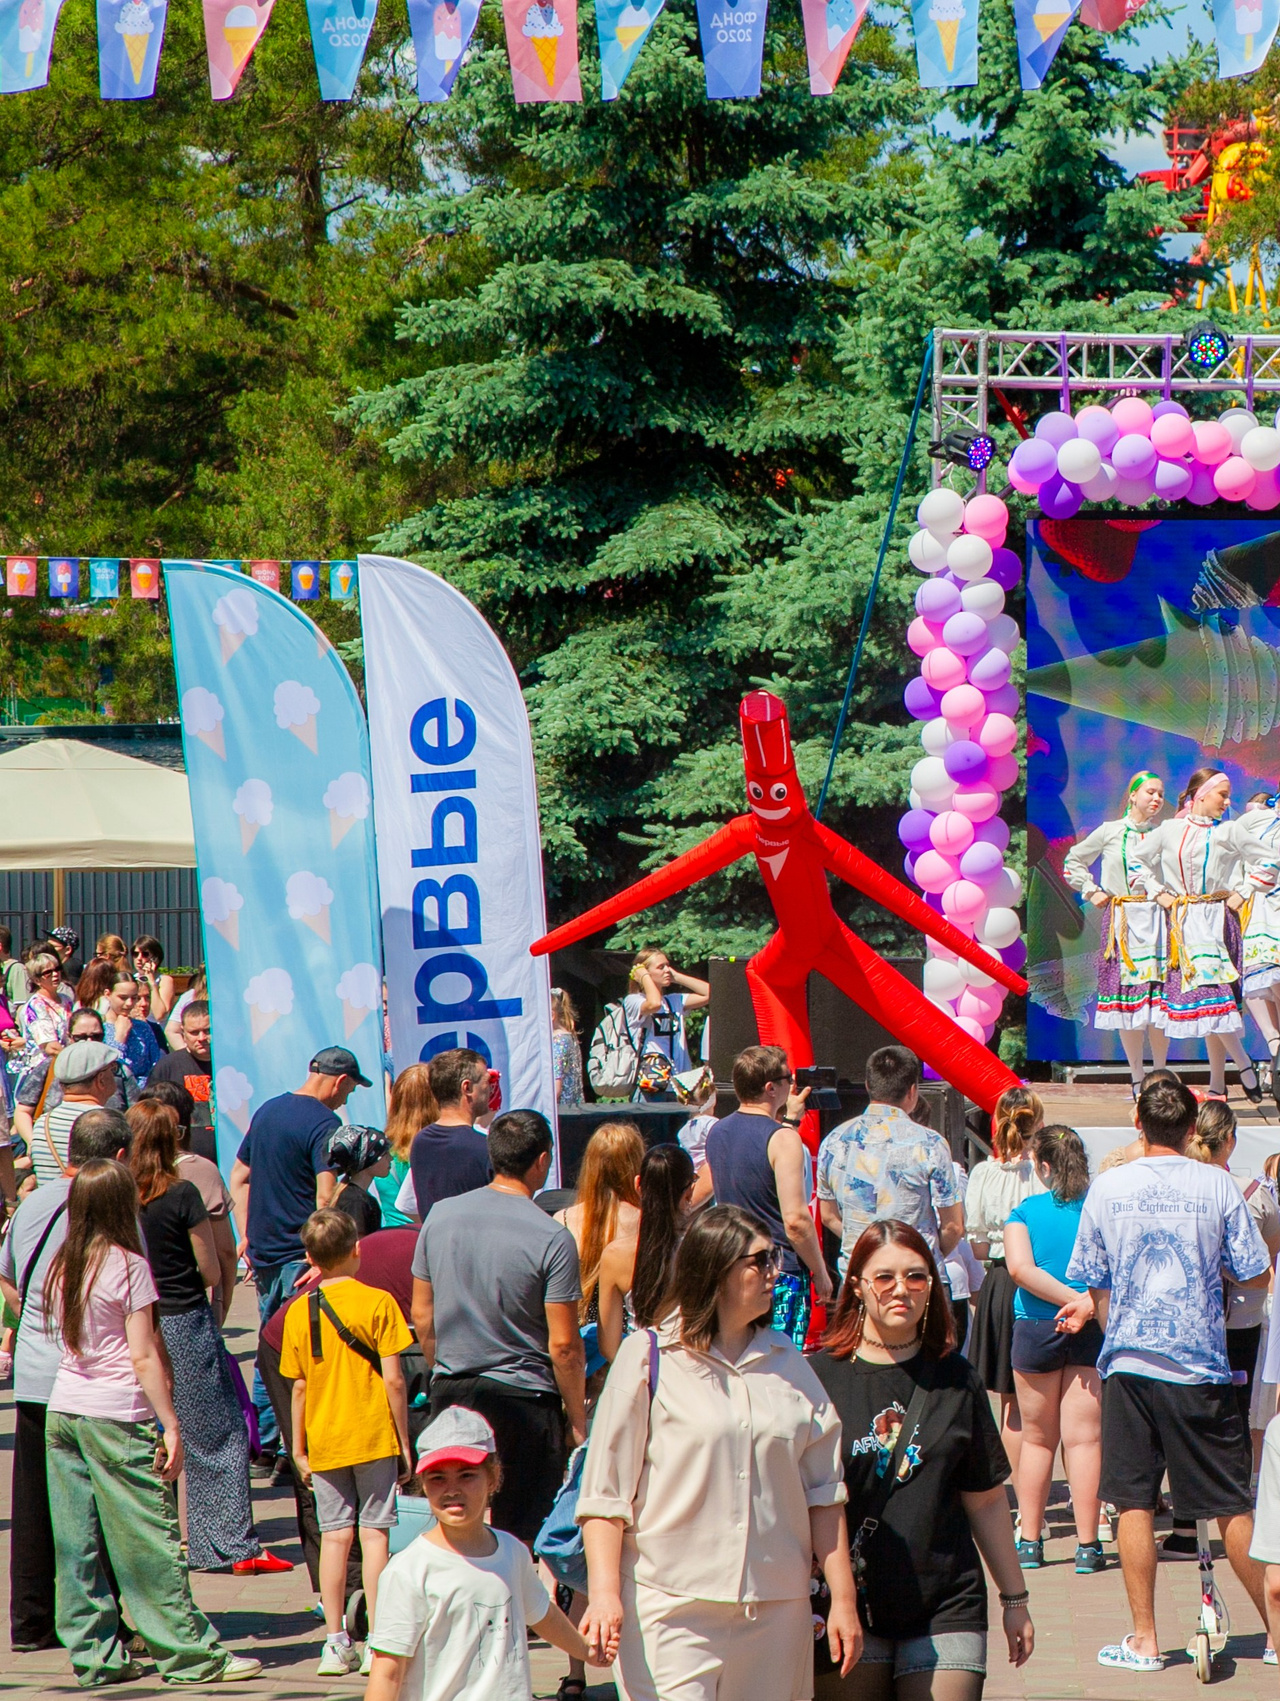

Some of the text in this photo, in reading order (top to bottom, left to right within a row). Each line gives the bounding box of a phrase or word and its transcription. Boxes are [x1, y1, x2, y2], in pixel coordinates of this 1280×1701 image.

[409, 697, 523, 1068] рвые
[1112, 1200, 1207, 1215] Plus Eighteen Club
[852, 1436, 883, 1456] AFK
